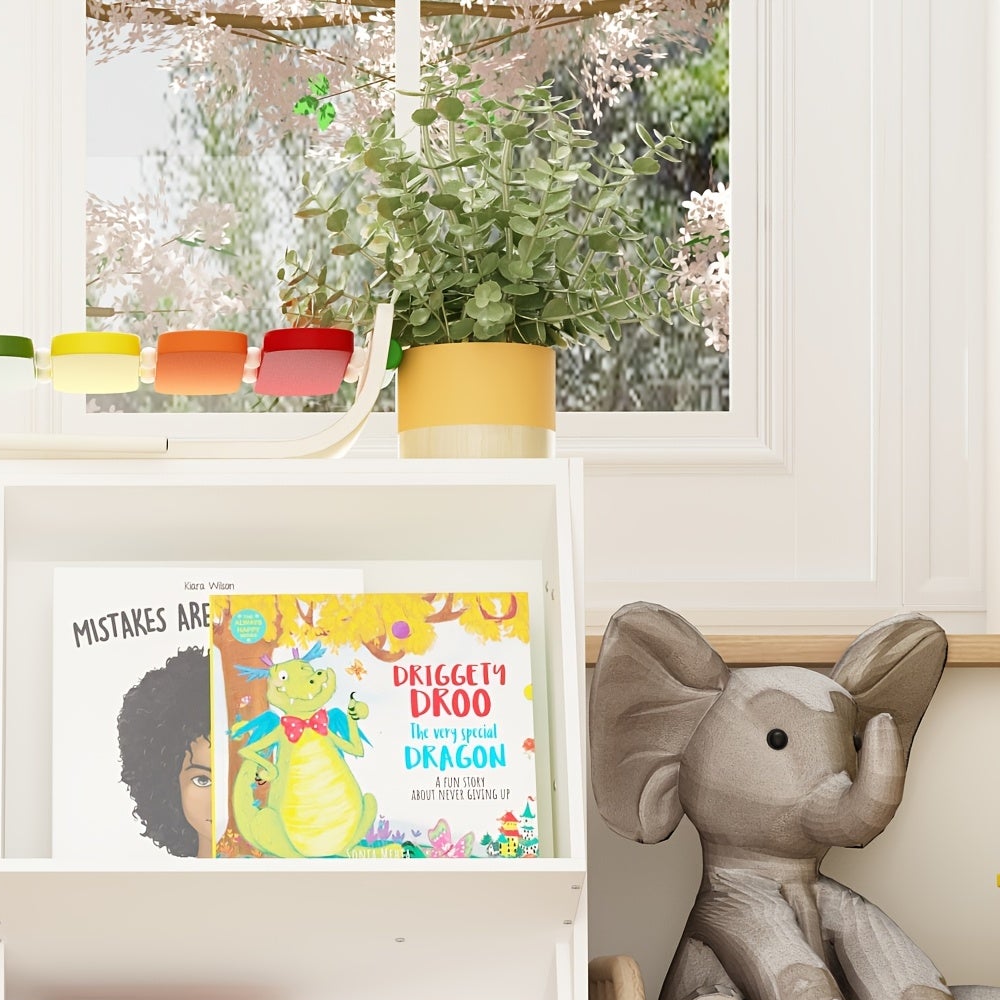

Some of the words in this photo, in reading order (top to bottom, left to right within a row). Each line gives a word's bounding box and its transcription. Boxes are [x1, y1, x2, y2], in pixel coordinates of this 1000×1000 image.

[184, 581, 205, 590] Kiara
[209, 581, 235, 590] Wilson
[73, 607, 167, 648] MISTAKES
[178, 601, 210, 632] ARE
[393, 662, 506, 687] DRIGGETY
[410, 688, 491, 718] DROO
[410, 722, 429, 740] The
[433, 727, 457, 744] very
[461, 722, 497, 744] special
[405, 743, 506, 771] DRAGON
[435, 776, 441, 788] A
[444, 776, 460, 788] FUN
[463, 776, 485, 788] STORY
[411, 789, 435, 800] ABOUT
[438, 789, 464, 800] NEVER
[467, 788, 498, 800] GIVING
[500, 788, 511, 800] UP
